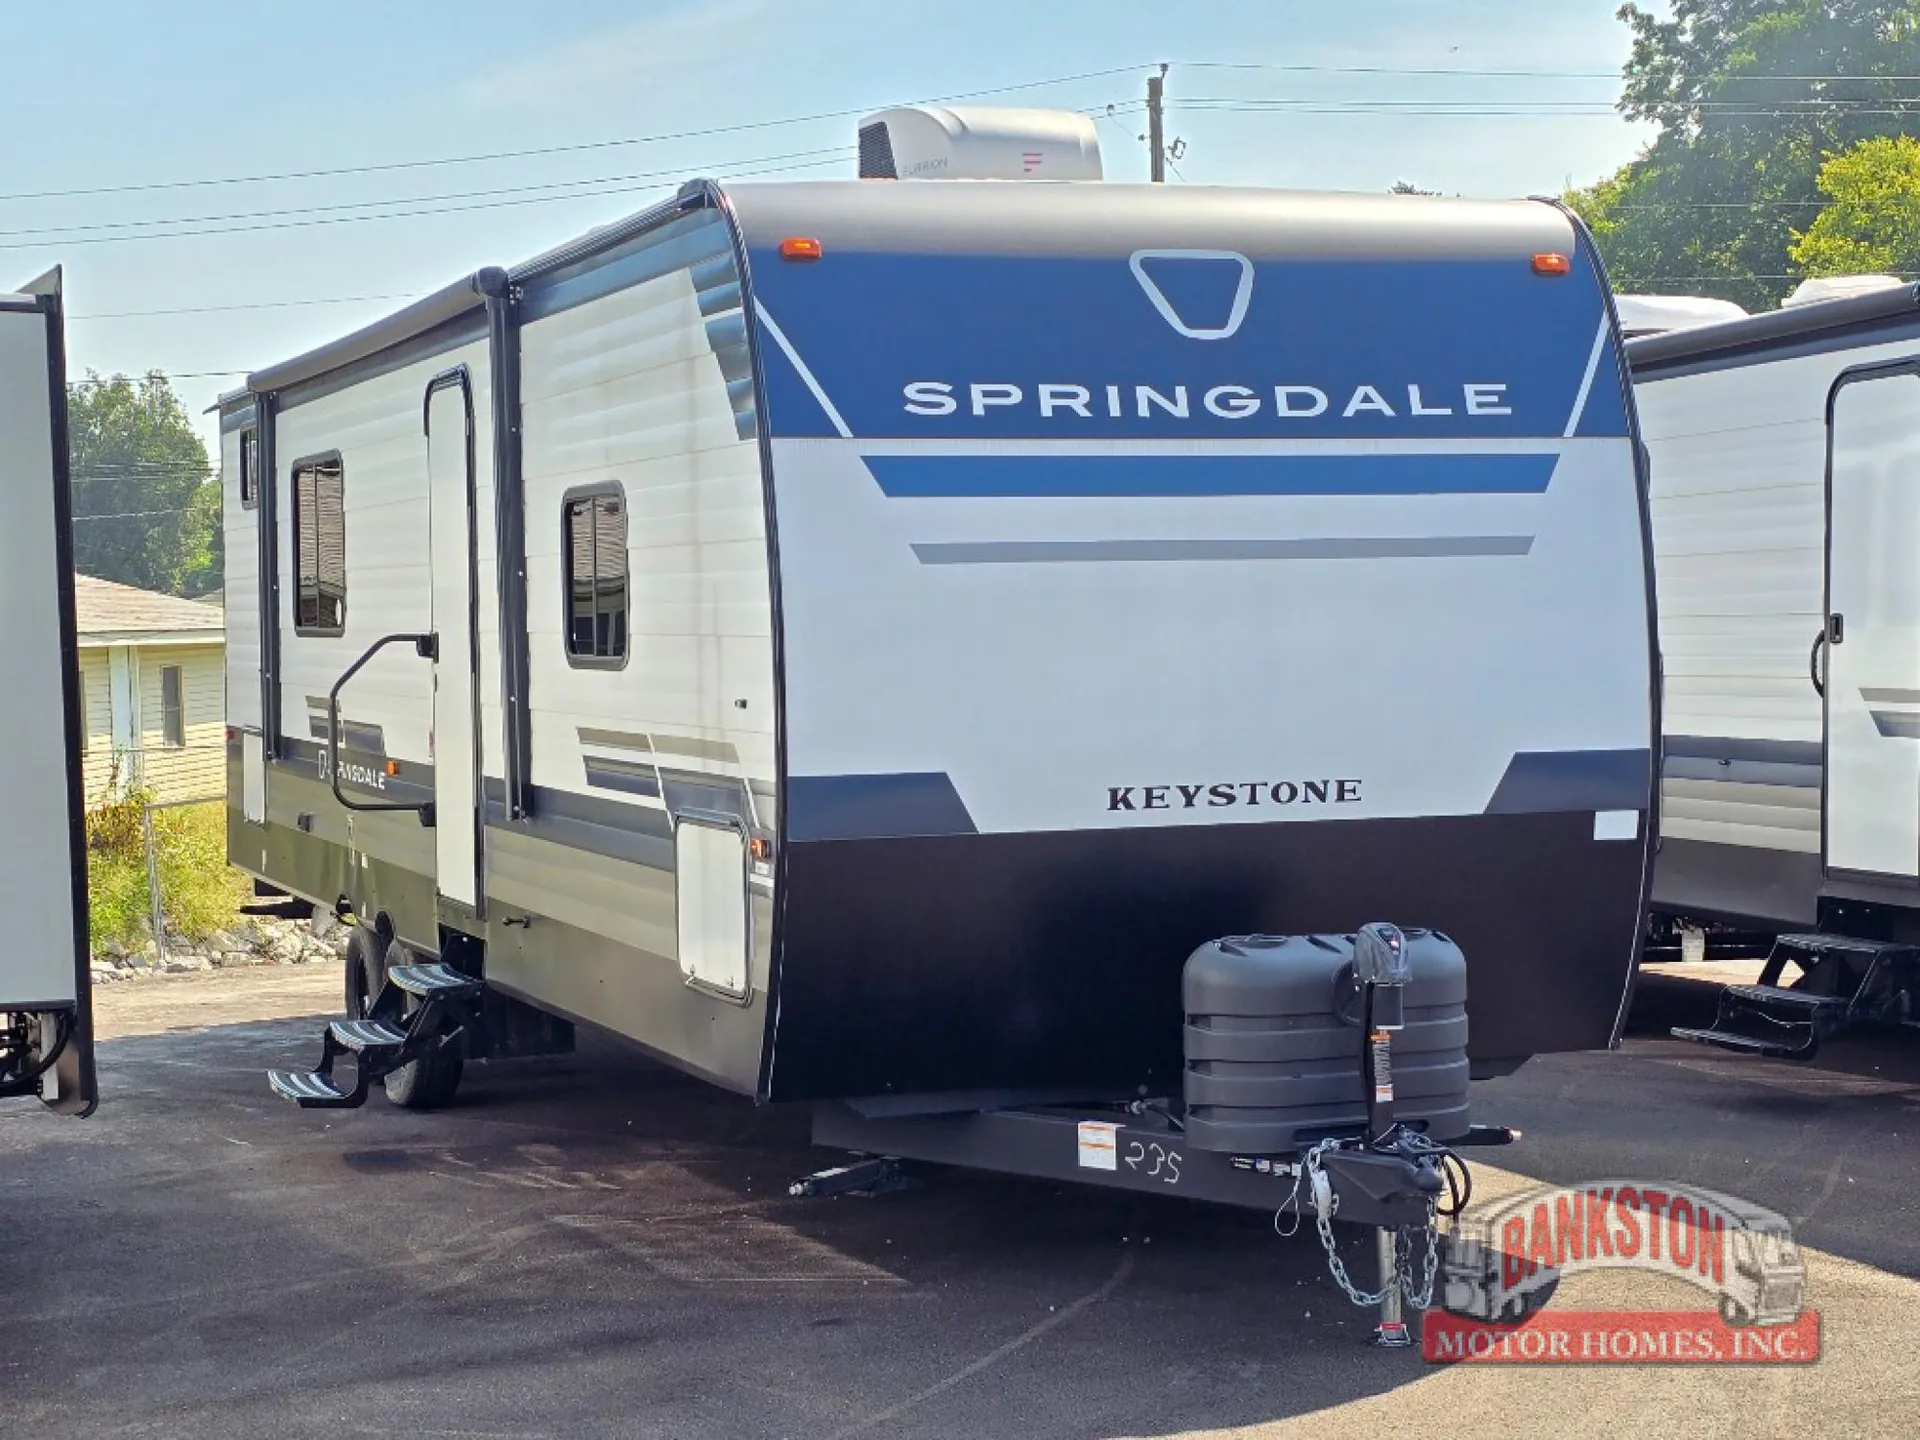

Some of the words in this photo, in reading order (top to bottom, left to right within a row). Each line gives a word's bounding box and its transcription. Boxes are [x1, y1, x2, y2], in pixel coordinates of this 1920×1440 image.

[902, 381, 1512, 418] SPRINGDALE
[1106, 779, 1362, 811] KEYSTONE
[1124, 1141, 1182, 1184] 235
